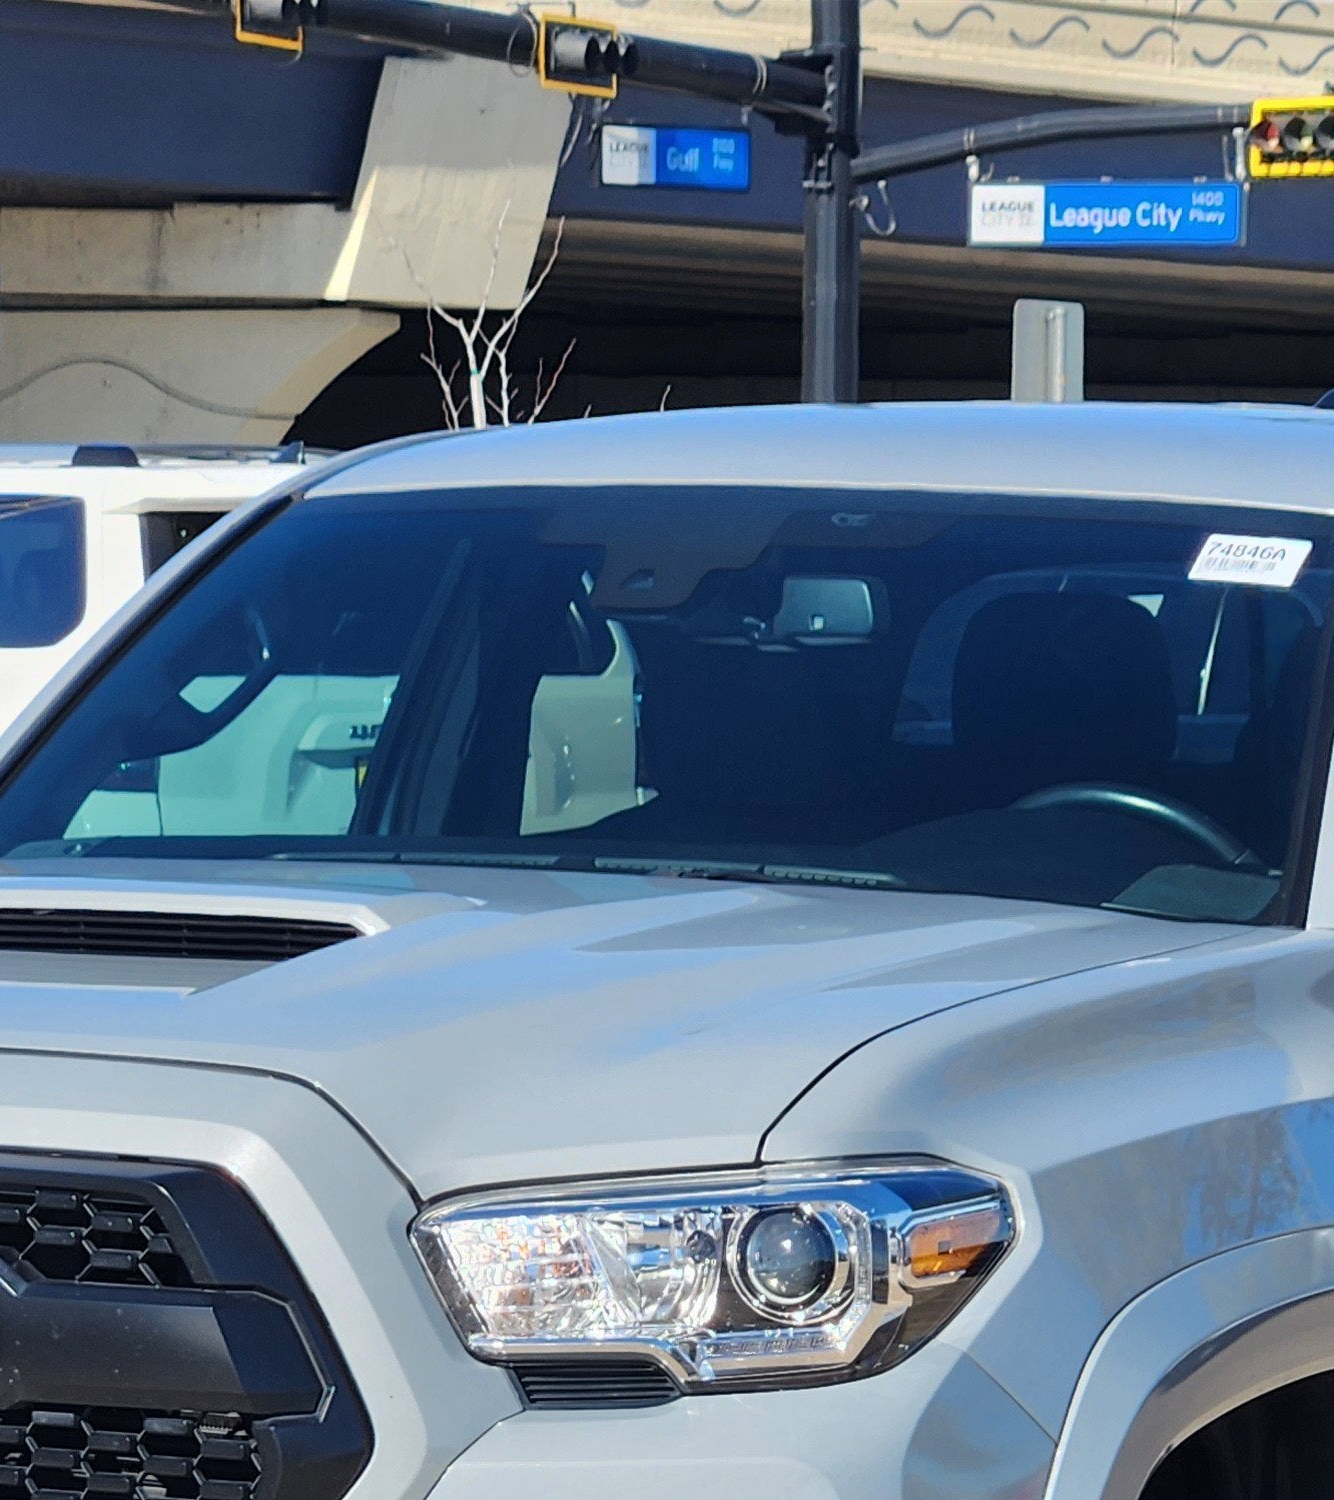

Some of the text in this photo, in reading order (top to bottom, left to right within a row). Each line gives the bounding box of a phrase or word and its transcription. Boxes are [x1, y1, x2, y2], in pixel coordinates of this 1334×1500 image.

[981, 200, 1035, 213] LEAGUE
[1049, 202, 1132, 234] League
[1135, 201, 1183, 232] City
[1207, 541, 1286, 561] 74846A
